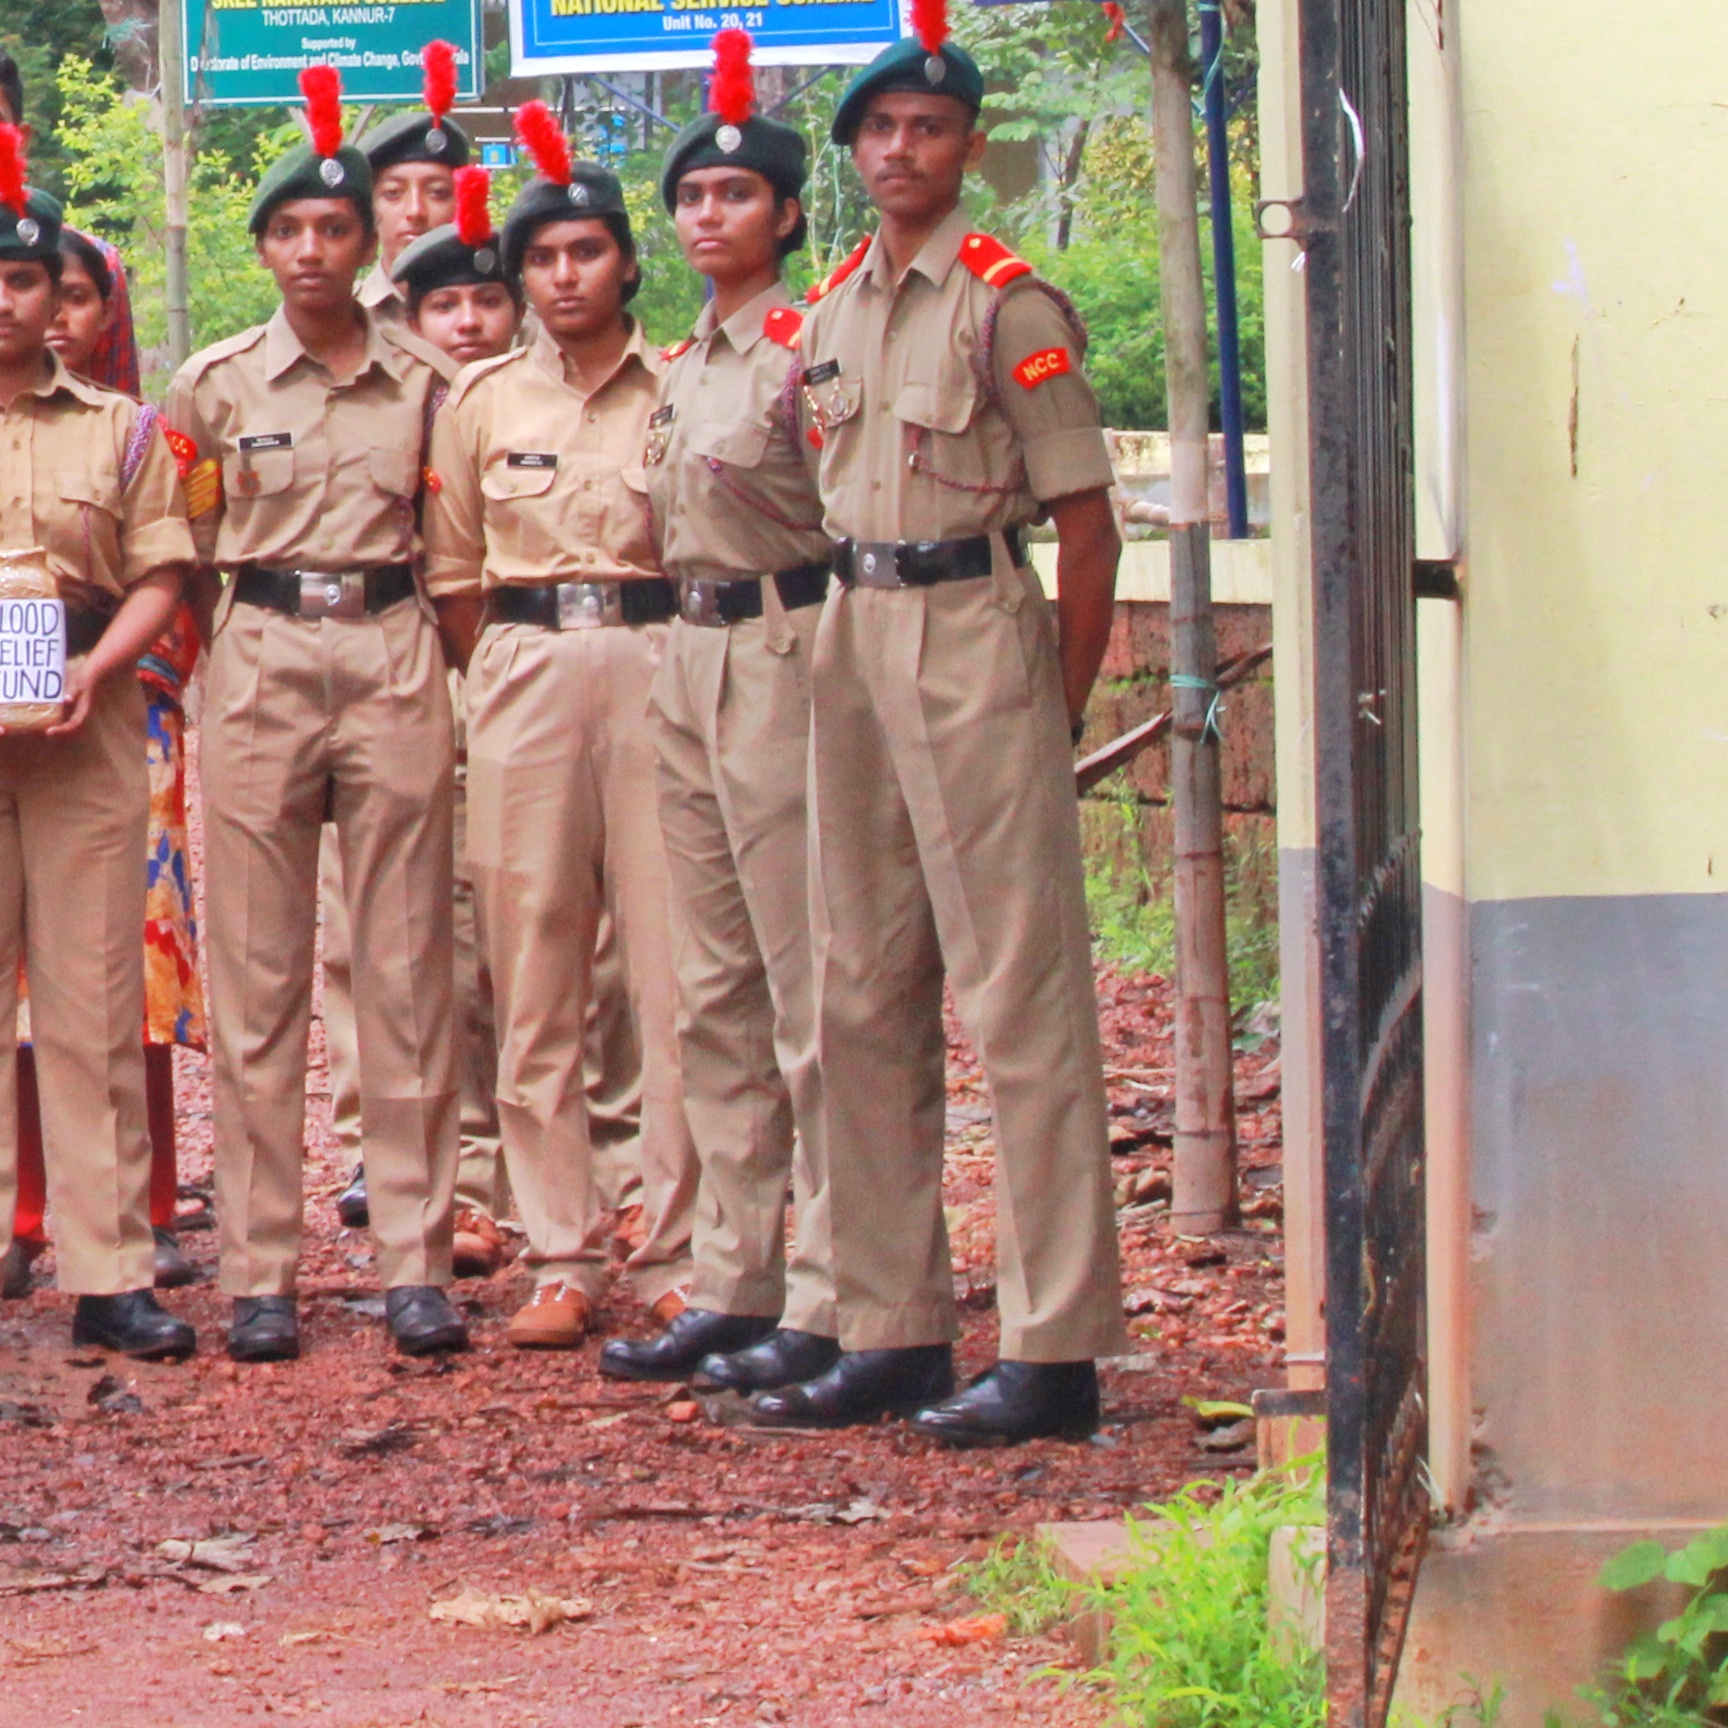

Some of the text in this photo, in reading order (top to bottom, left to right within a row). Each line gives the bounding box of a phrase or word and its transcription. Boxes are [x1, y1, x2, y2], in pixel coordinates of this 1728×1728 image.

[262, 7, 395, 27] THOTTADA, KANNUR-7
[663, 12, 764, 32] Unit No. 20, 21
[301, 36, 356, 51] Supported by
[328, 52, 362, 68] Climate
[1021, 352, 1060, 381] NCC
